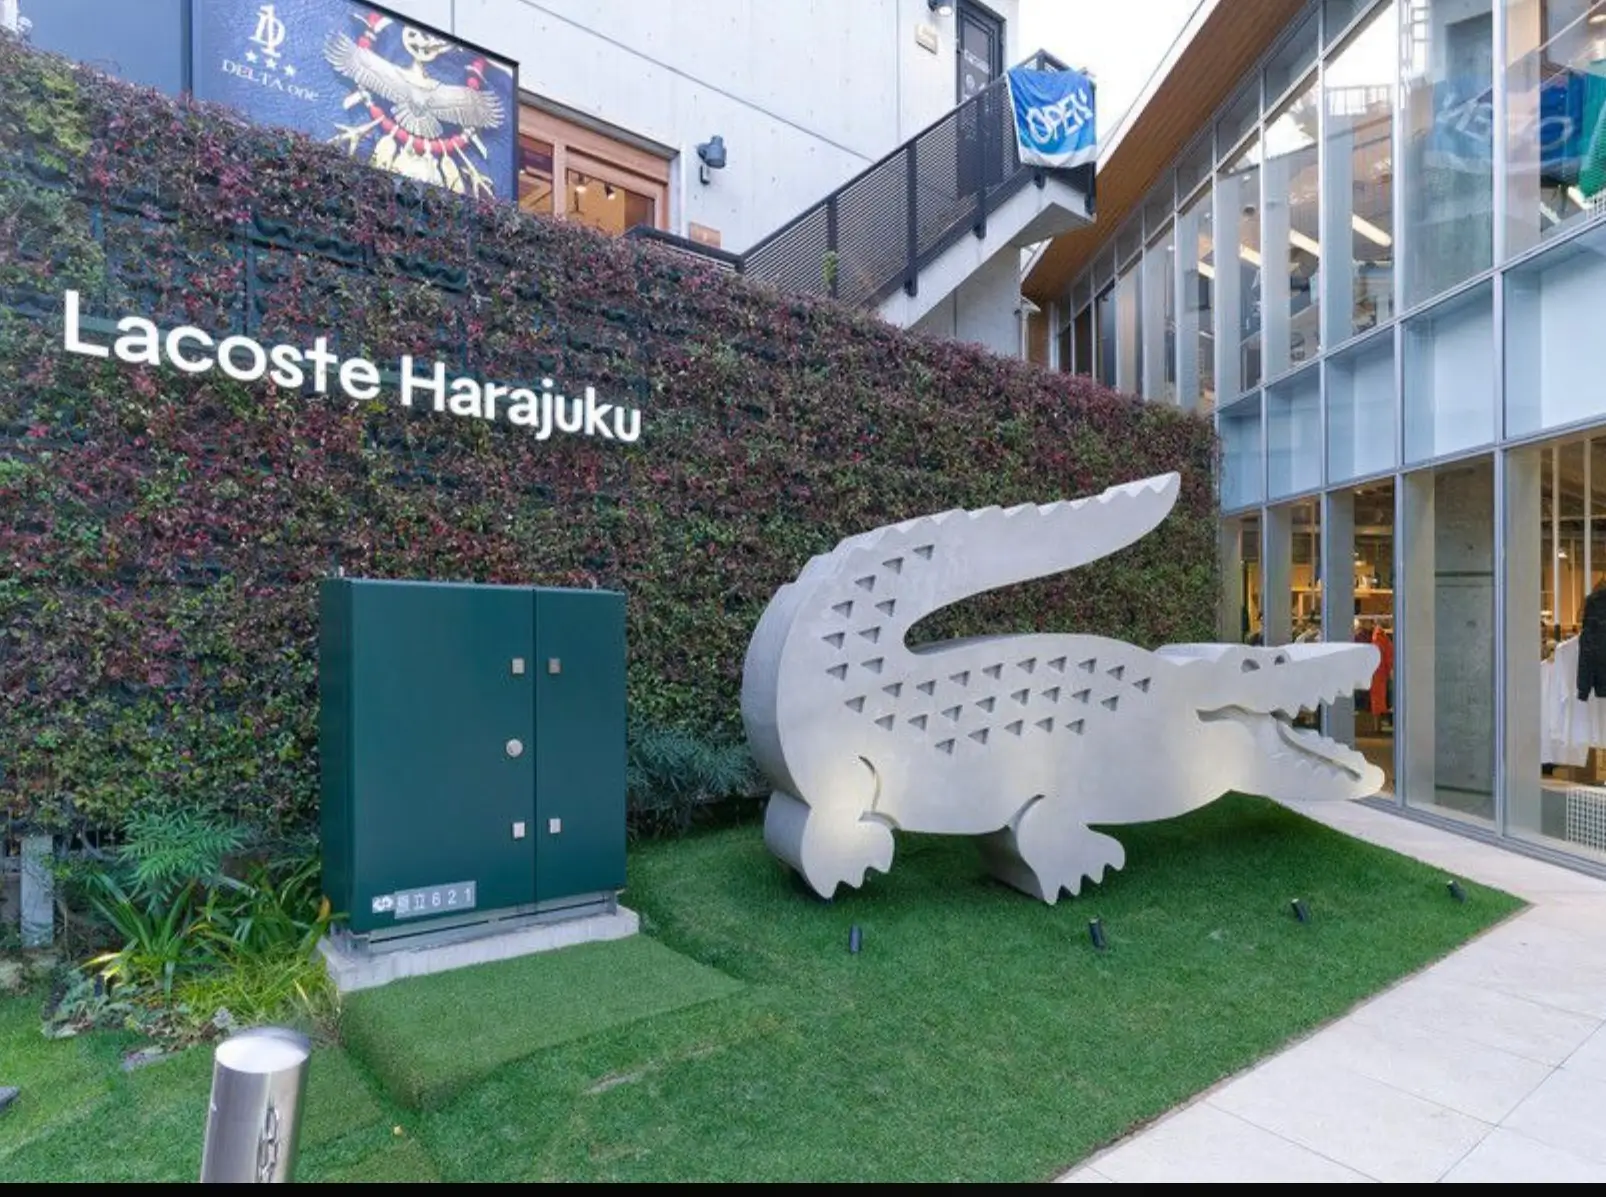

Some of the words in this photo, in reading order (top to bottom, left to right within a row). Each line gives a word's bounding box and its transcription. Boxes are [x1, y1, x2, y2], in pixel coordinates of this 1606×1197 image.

[1027, 88, 1093, 143] OPEN
[64, 289, 381, 400] Lacoste
[401, 355, 641, 442] Harajuku
